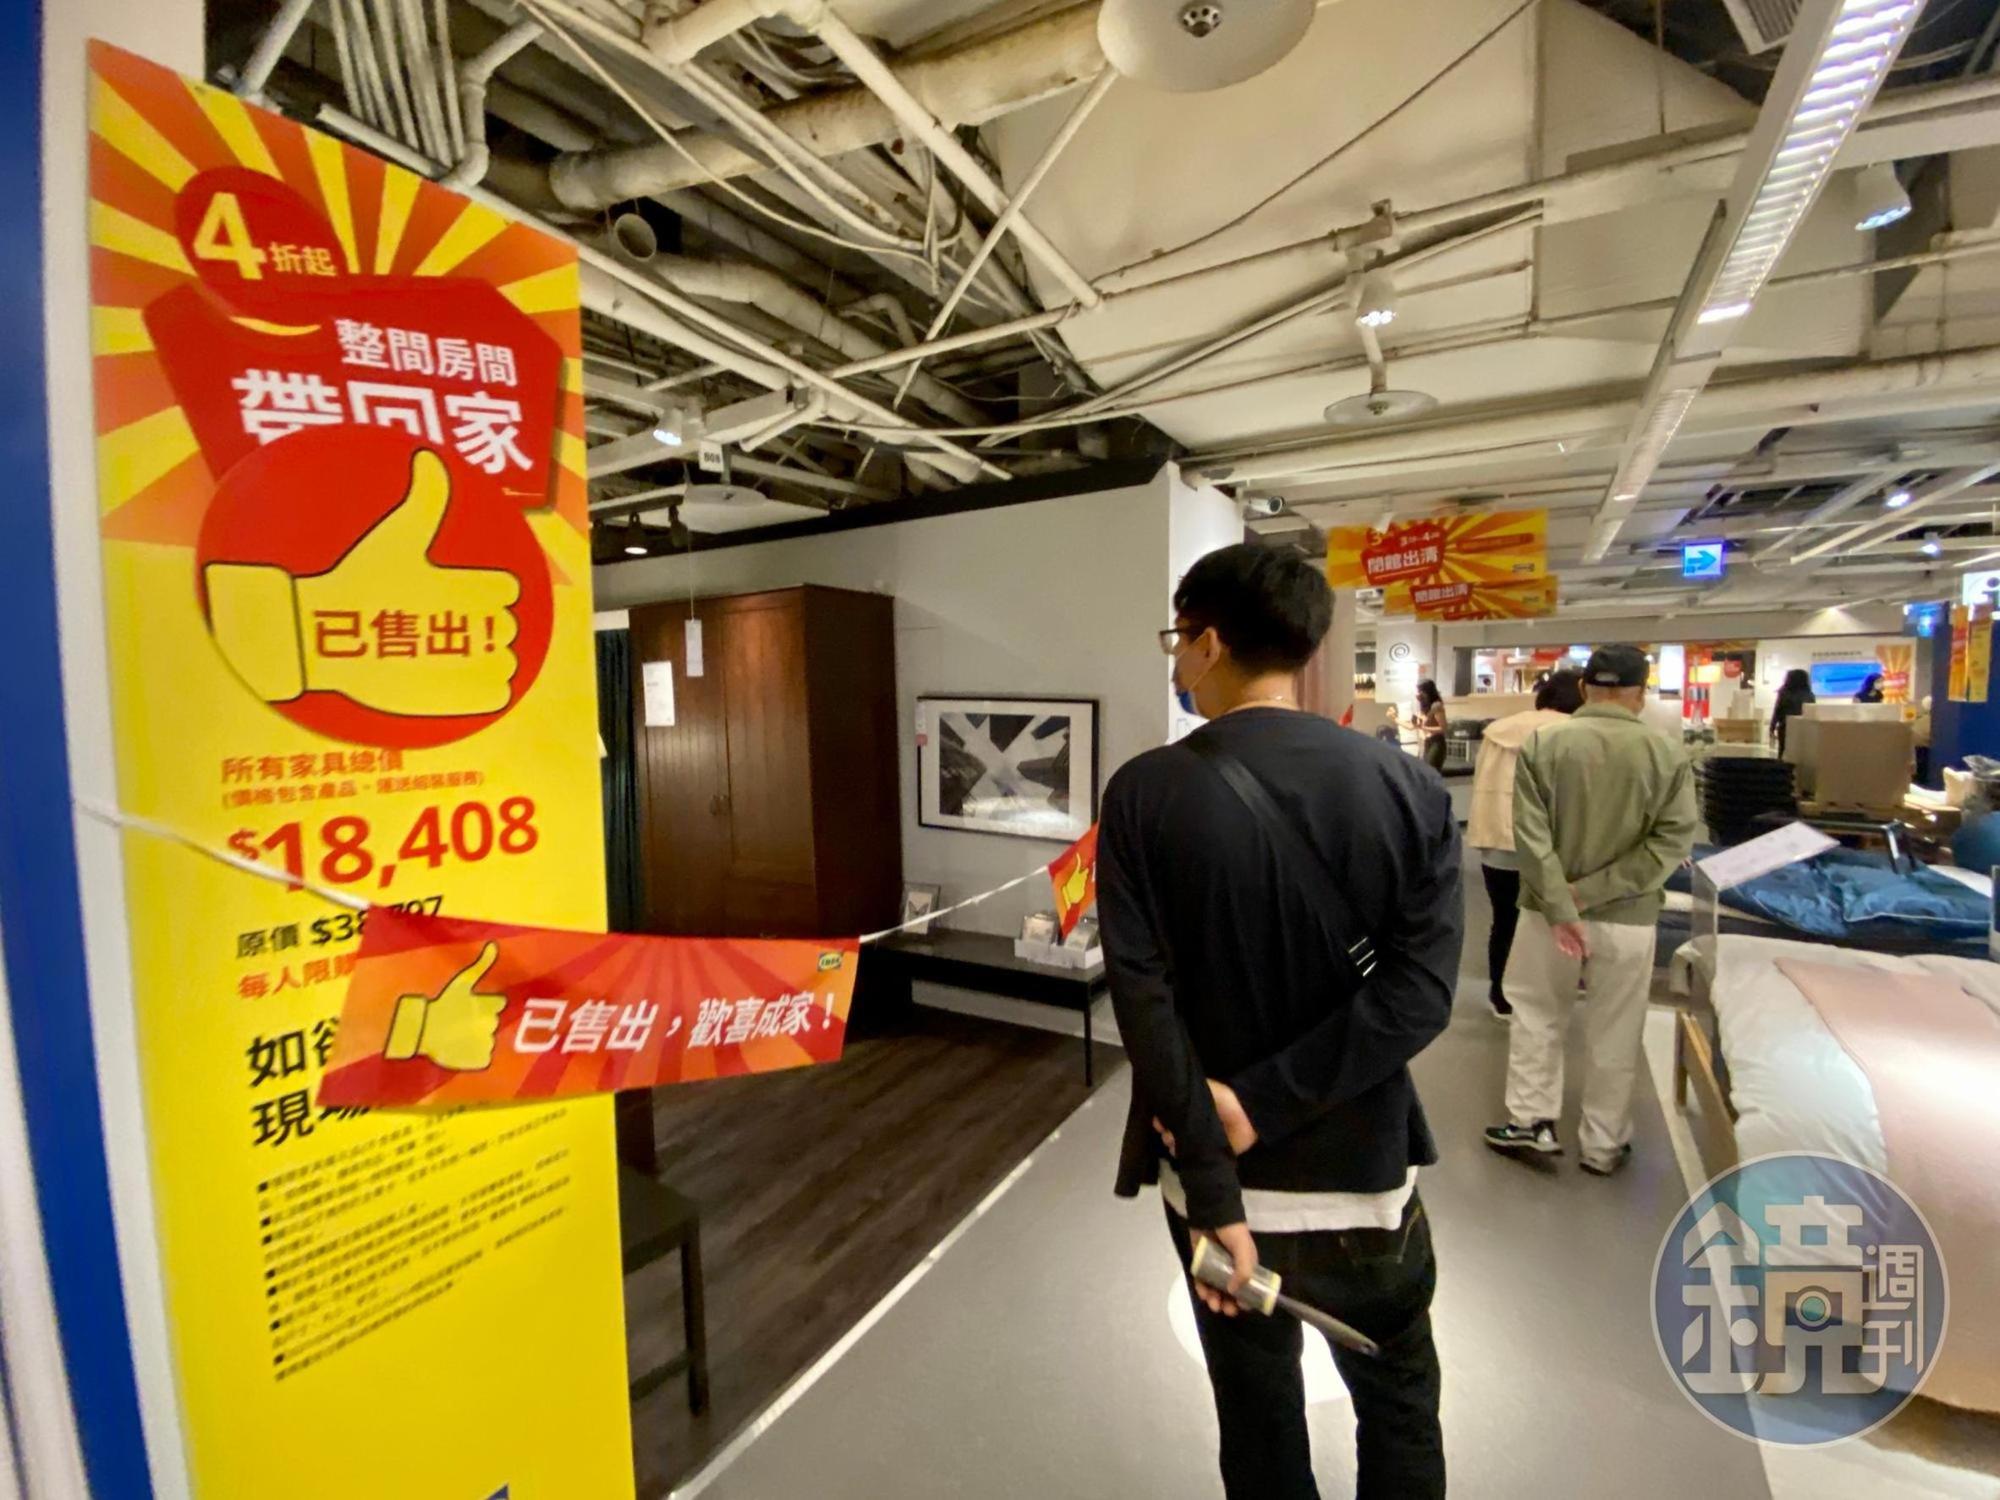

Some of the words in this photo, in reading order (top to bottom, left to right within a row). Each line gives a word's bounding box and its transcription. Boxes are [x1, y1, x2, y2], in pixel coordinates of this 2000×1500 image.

[193, 191, 337, 280] 4折起
[334, 319, 518, 387] 整間房間
[313, 608, 497, 660] 已售出!
[227, 796, 540, 893] $18,408
[513, 991, 835, 1054] 已售出，歡喜成家！
